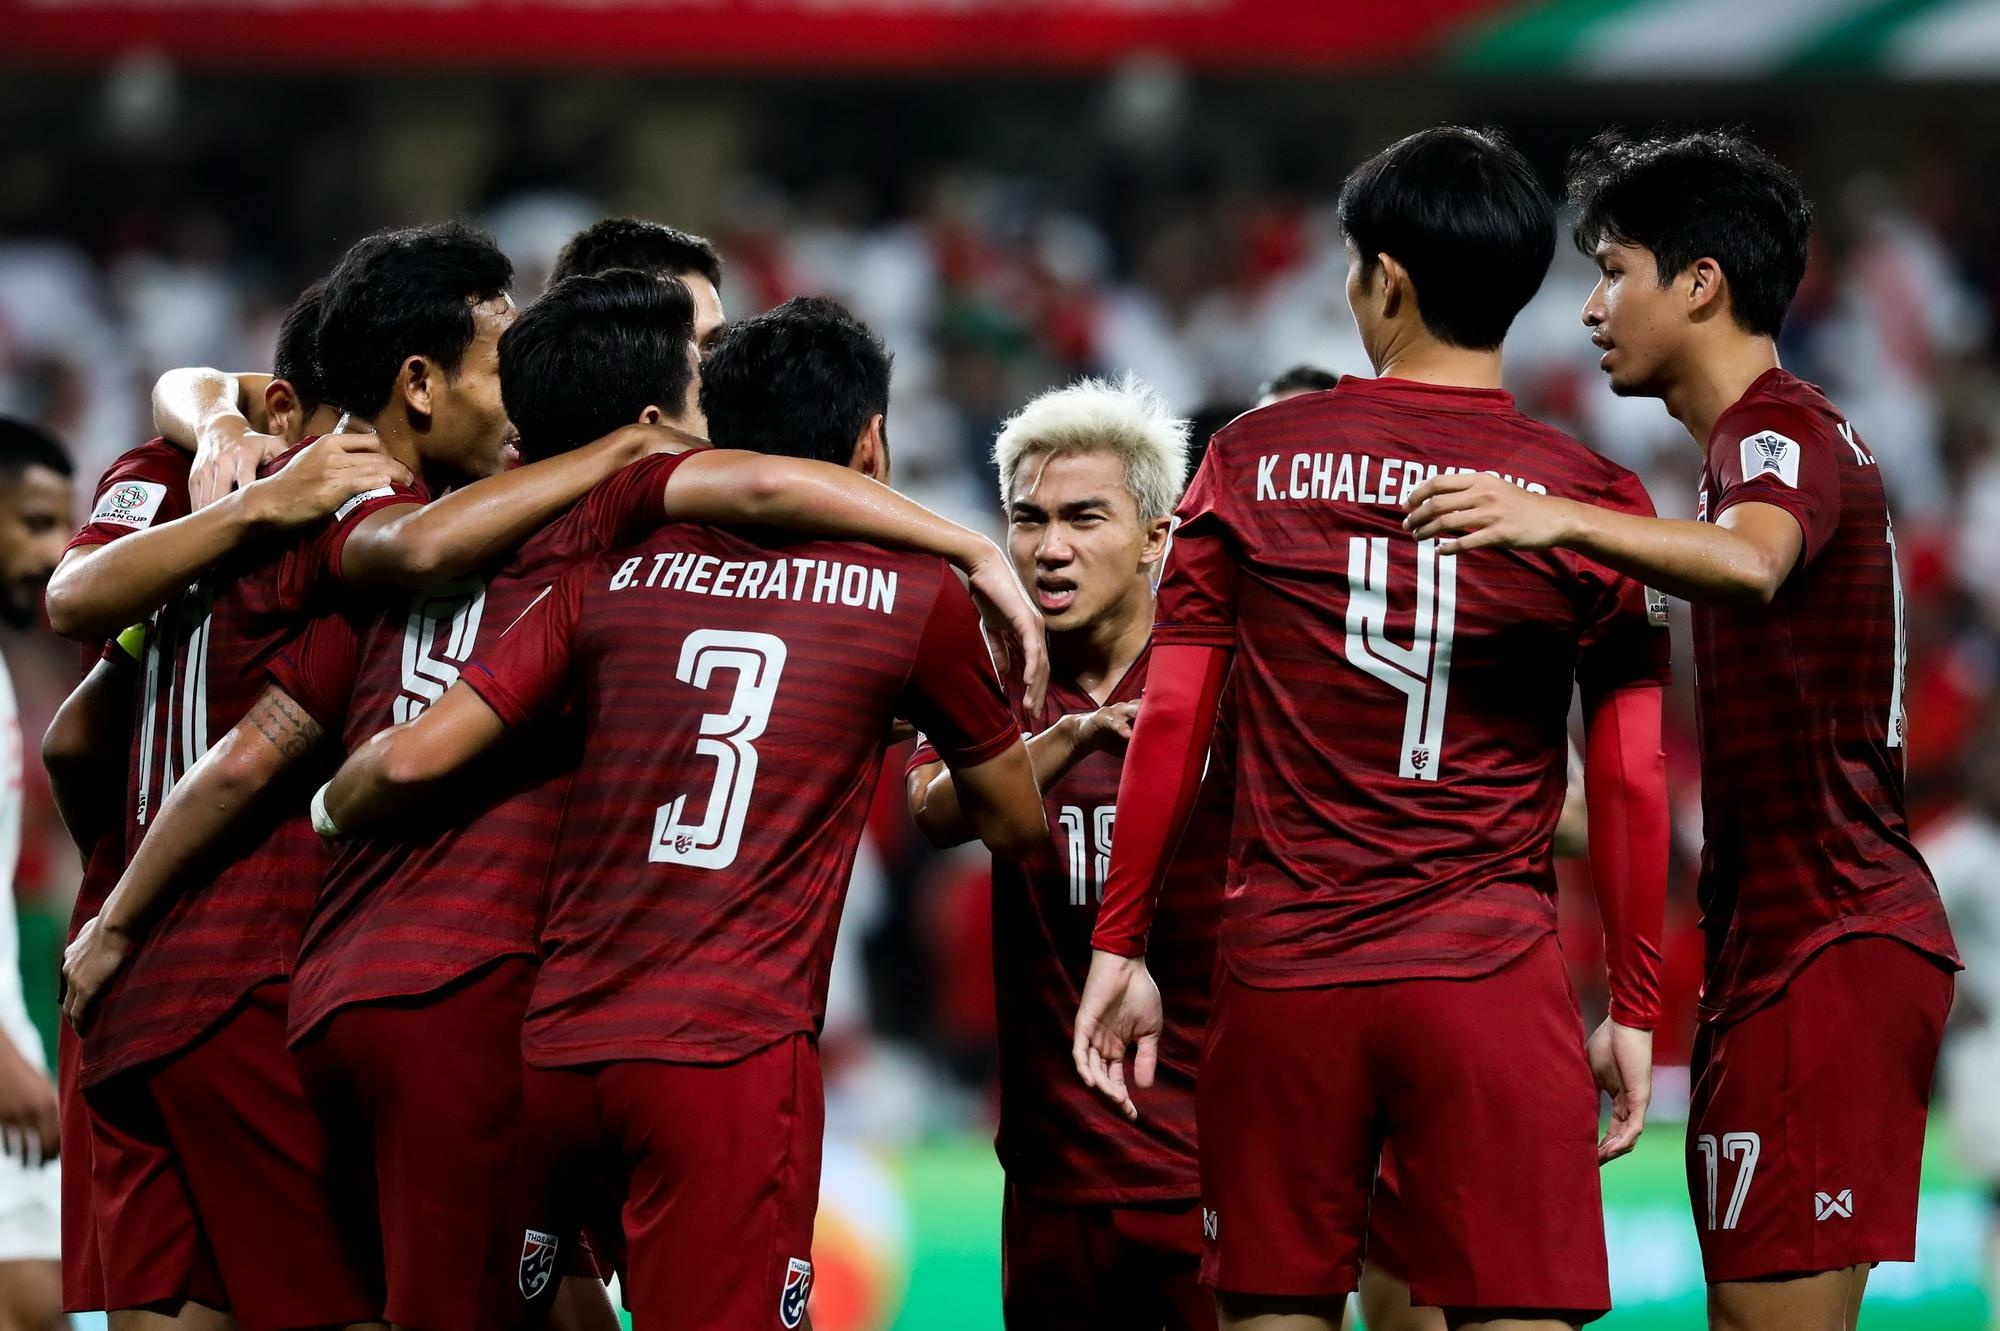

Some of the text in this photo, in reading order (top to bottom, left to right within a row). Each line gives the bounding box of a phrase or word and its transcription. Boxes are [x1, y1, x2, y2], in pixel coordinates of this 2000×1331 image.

[609, 552, 898, 615] B.THEERATHON
[1345, 536, 1457, 782] 4
[648, 628, 788, 871] 3
[1697, 1131, 1761, 1231] 17
